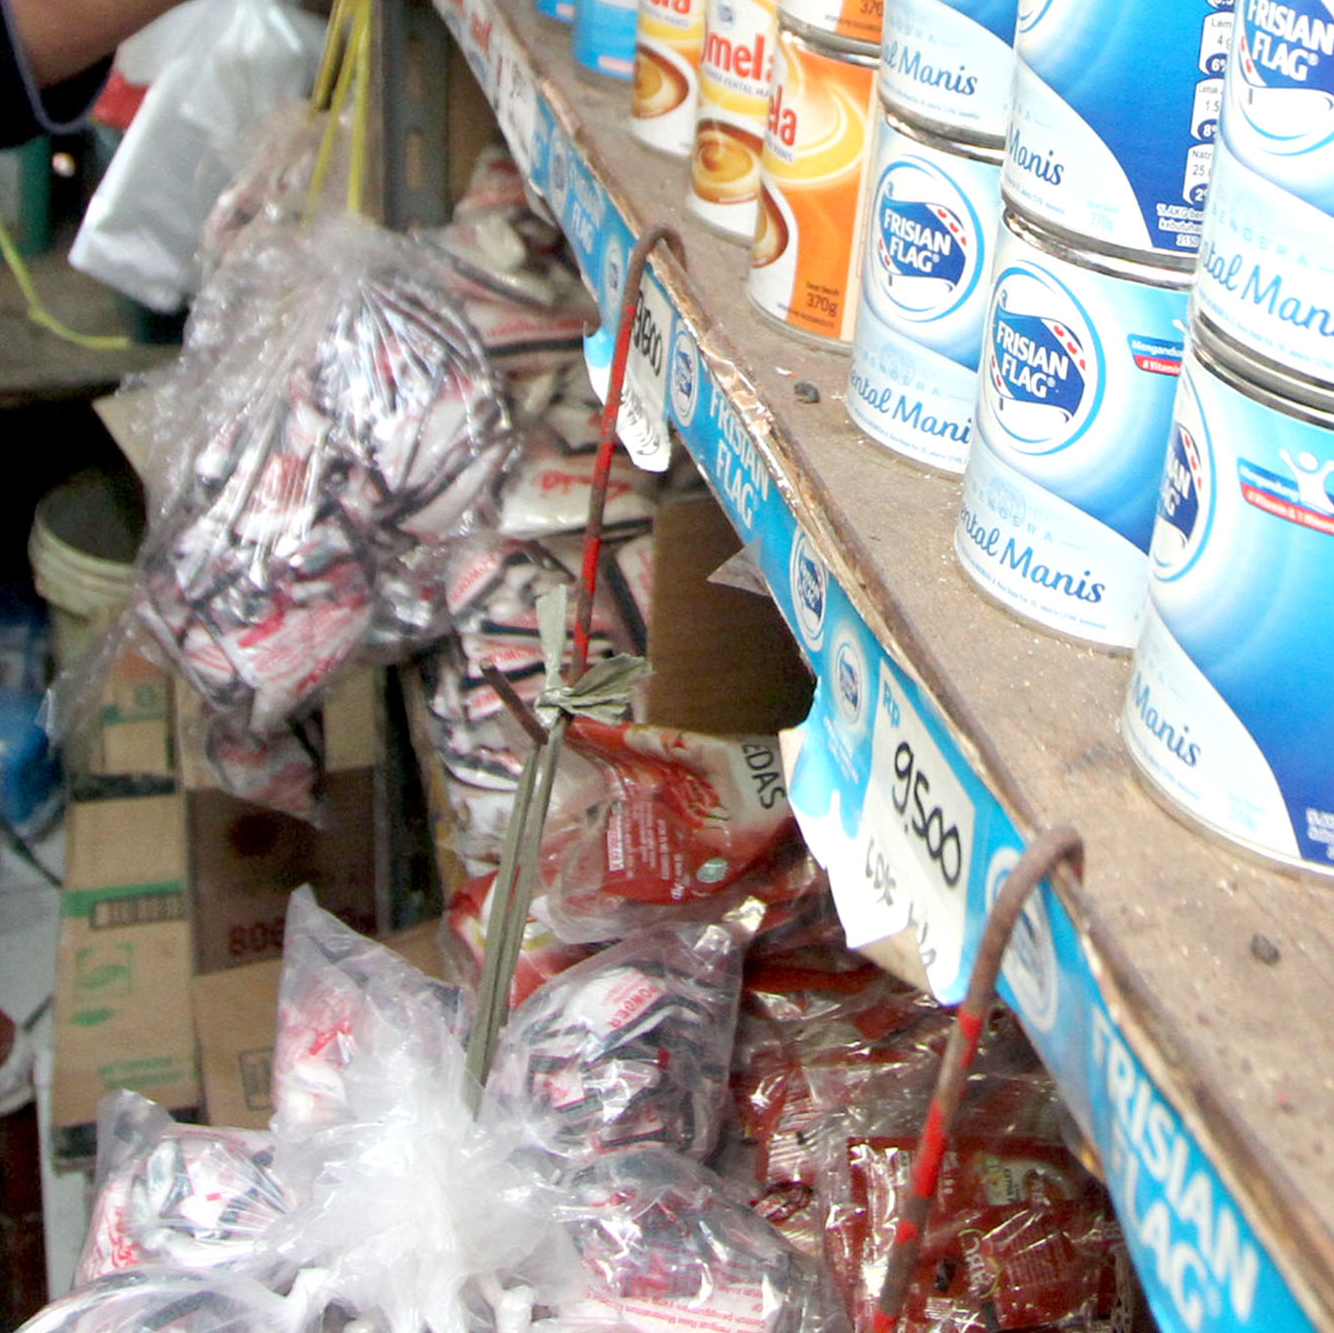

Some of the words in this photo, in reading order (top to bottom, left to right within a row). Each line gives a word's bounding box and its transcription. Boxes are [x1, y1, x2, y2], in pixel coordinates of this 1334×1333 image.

[700, 30, 775, 82] mel
[897, 45, 979, 97] Manis
[1205, 100, 1220, 113] 1.5
[1007, 121, 1065, 187] Manis
[1192, 164, 1205, 177] 25
[883, 208, 952, 256] FRISIAN
[805, 291, 838, 318] 370g
[996, 320, 1069, 381] FRISIAN
[851, 373, 892, 414] ental
[892, 394, 972, 444] Mani
[709, 385, 768, 502] FRISIAN
[960, 509, 1001, 557] ental
[999, 537, 1106, 604] Manis
[1133, 670, 1202, 768] Manis
[1091, 1004, 1259, 1326] FRISIAN
